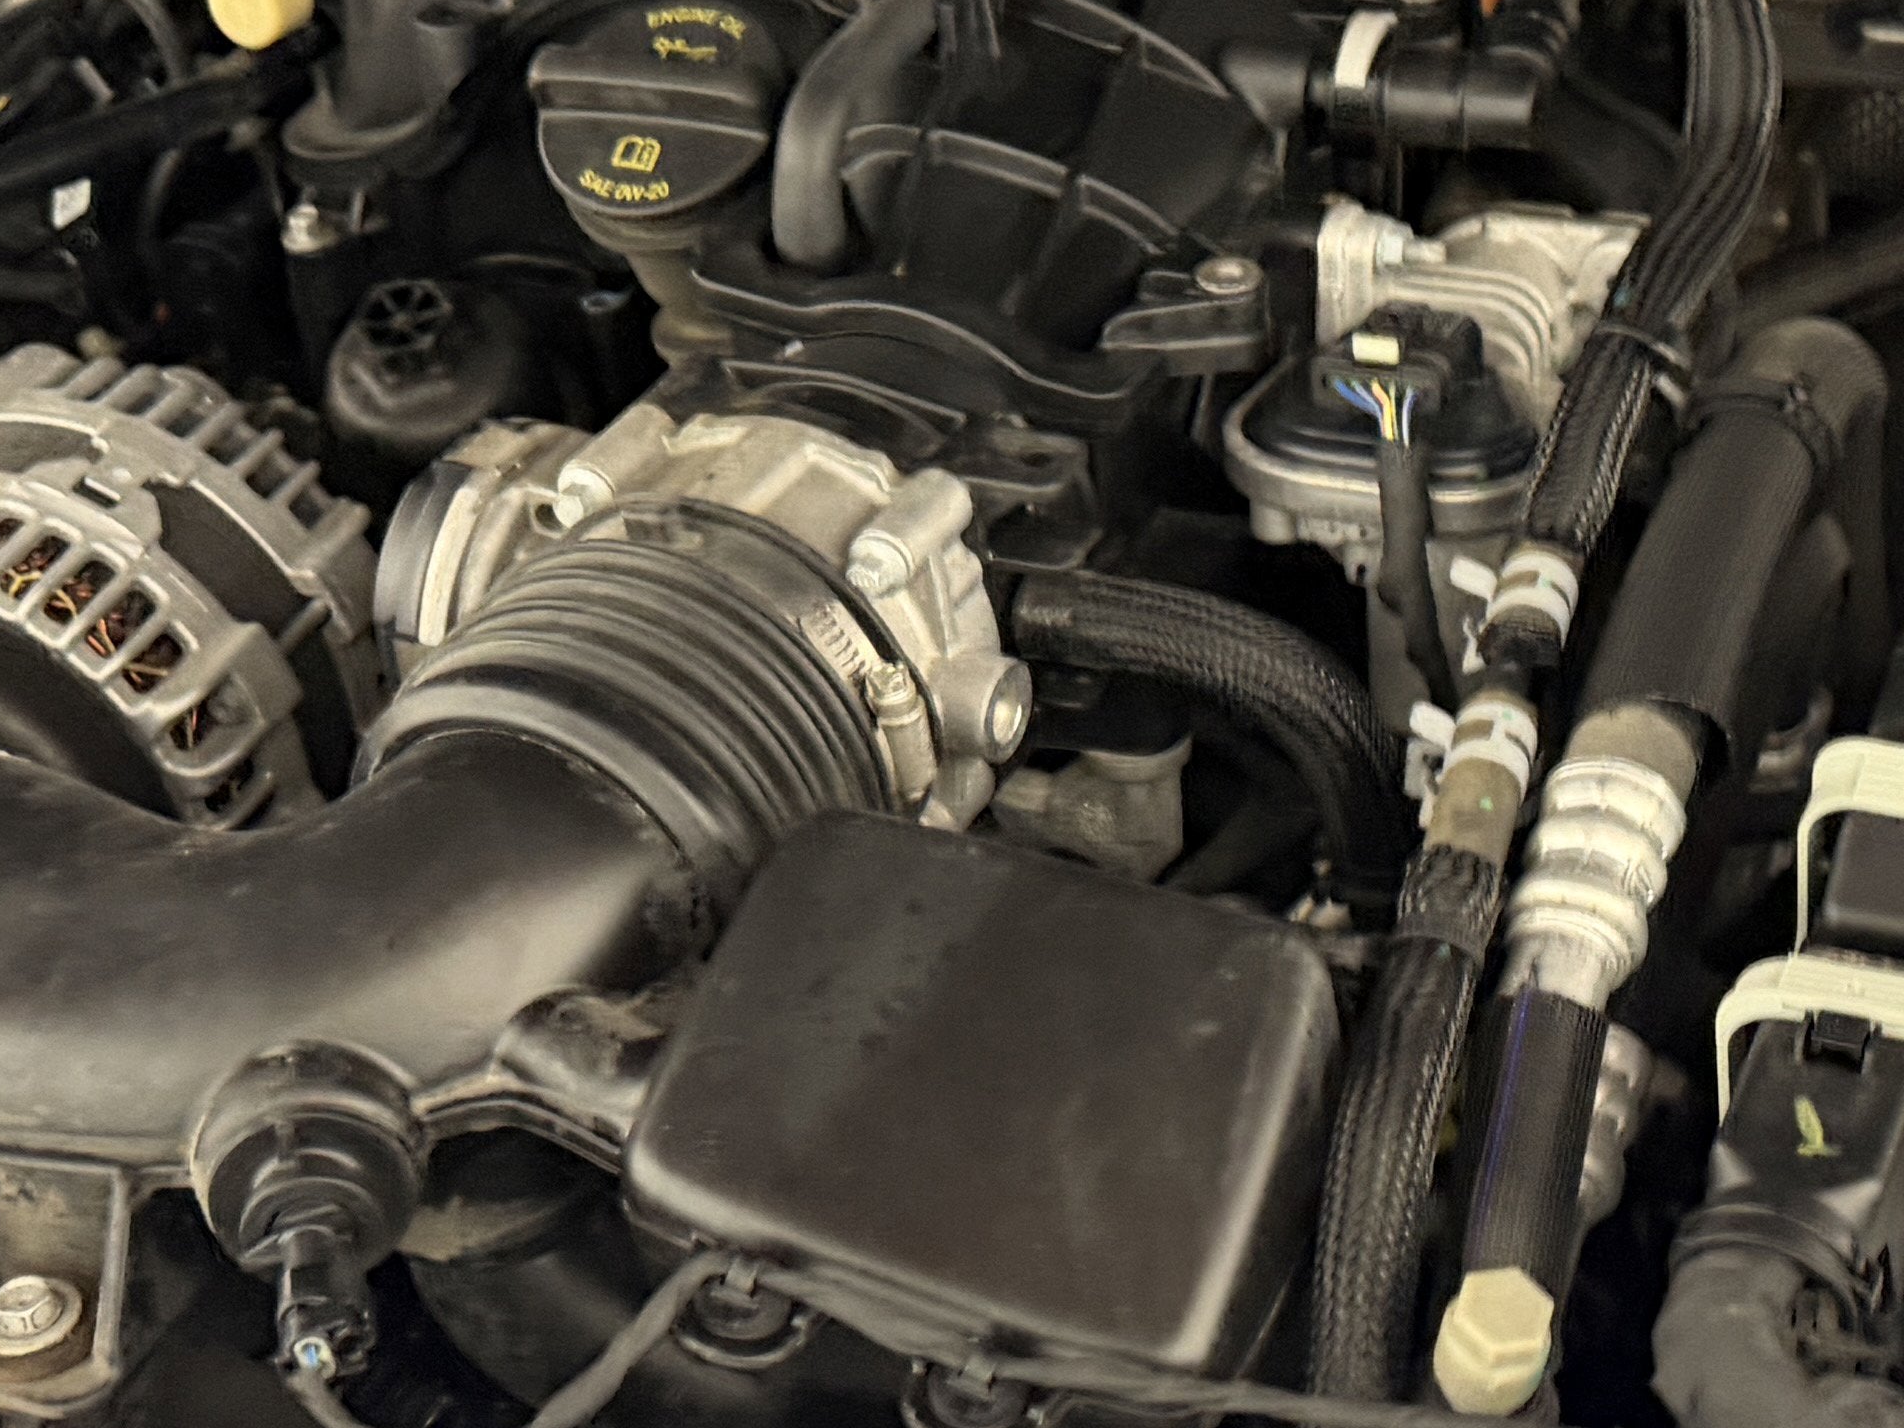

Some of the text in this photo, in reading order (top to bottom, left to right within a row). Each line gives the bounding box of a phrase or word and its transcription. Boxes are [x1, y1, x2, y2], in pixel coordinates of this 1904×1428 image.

[645, 5, 746, 40] ENGINE OIL
[579, 169, 669, 201] SAE 0W-20
